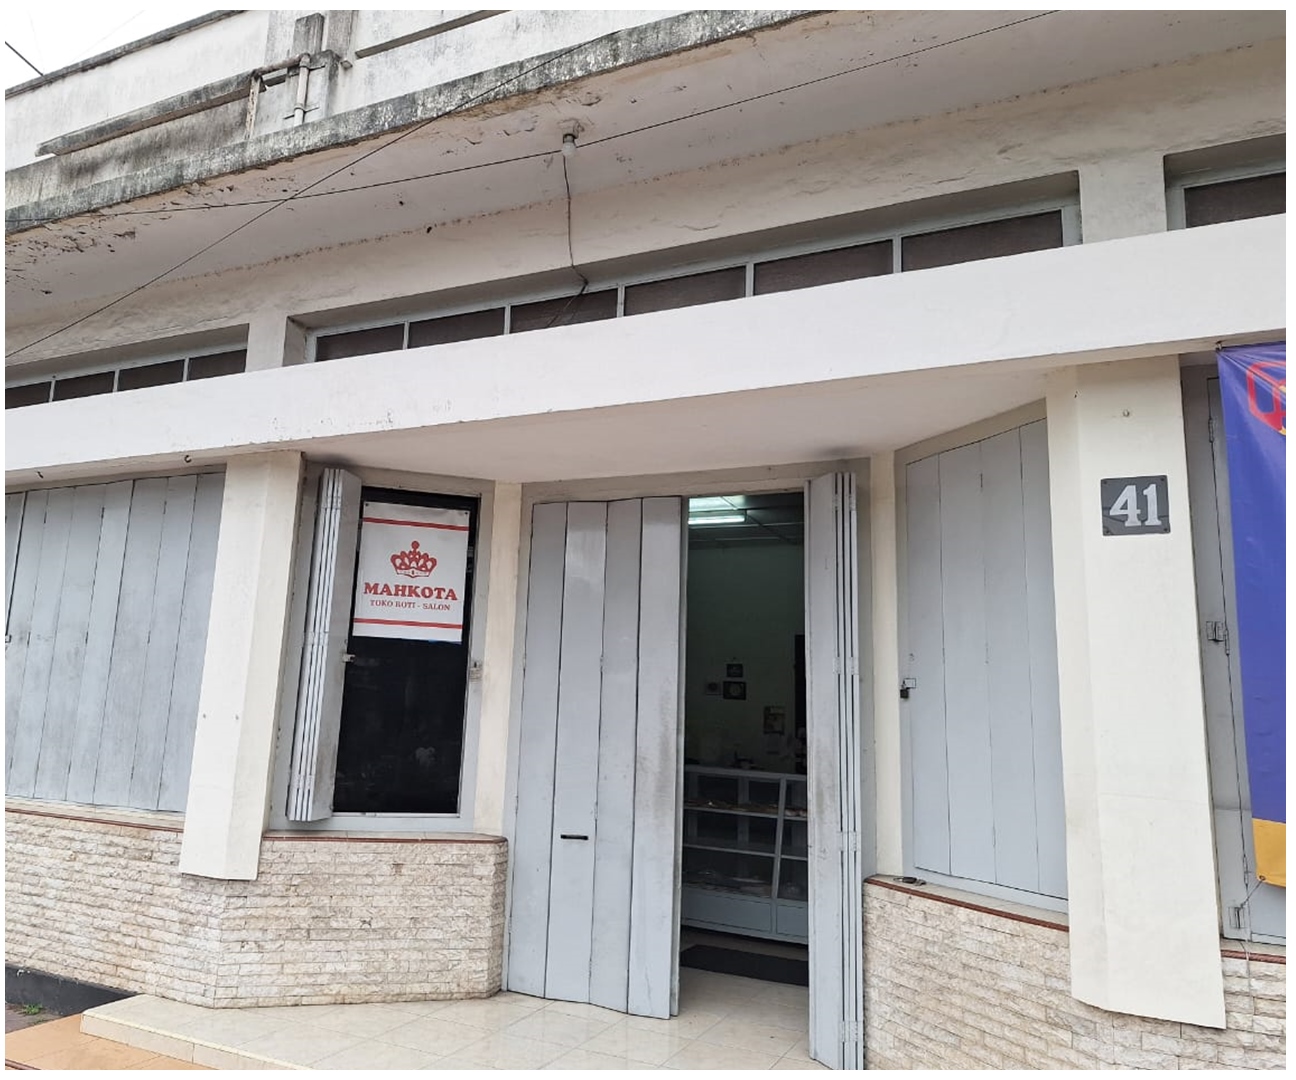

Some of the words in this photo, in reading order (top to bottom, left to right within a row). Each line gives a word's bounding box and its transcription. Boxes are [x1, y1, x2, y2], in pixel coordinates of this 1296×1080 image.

[1109, 483, 1162, 527] 41
[363, 582, 458, 601] MAHKOTA
[370, 599, 394, 608] TOKO
[395, 601, 416, 609] ROTI
[422, 602, 451, 611] SALON
